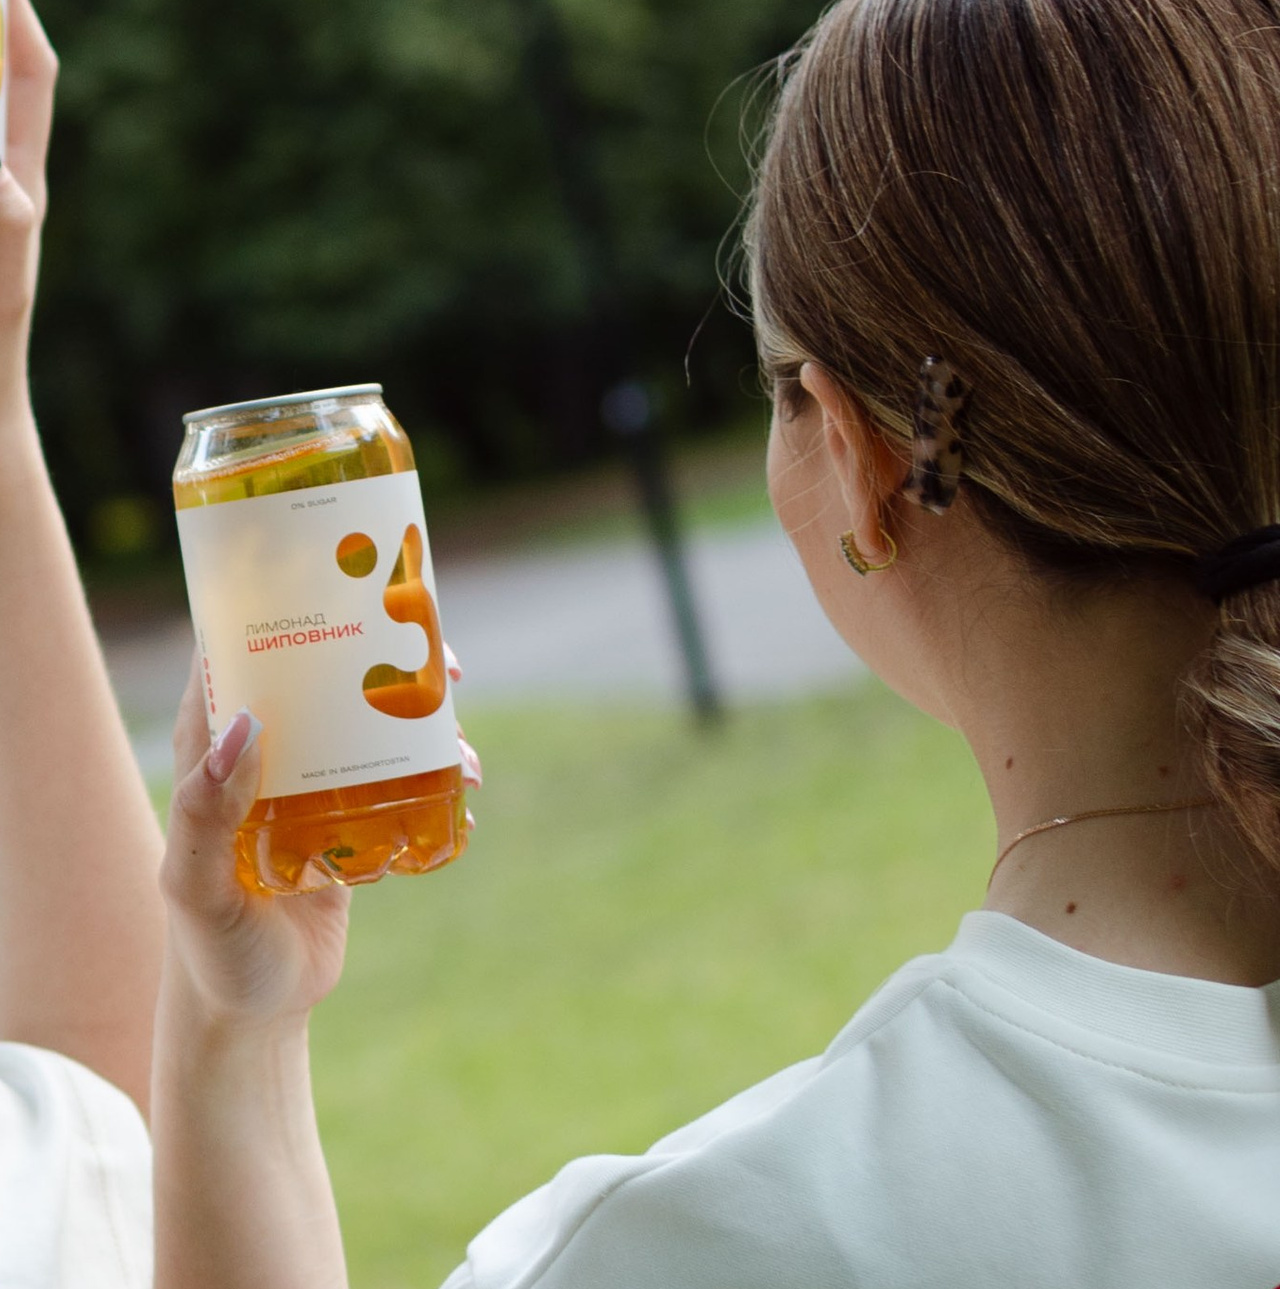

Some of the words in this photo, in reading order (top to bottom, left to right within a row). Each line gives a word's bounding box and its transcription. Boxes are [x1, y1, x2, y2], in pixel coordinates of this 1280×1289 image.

[307, 496, 338, 509] SUGAR
[245, 613, 326, 636] ЛИМОНАД
[247, 622, 365, 653] ШИПОВНИК
[301, 769, 326, 779] MADE
[328, 767, 338, 775] IN
[340, 755, 411, 774] BASHKORTOSTAN
